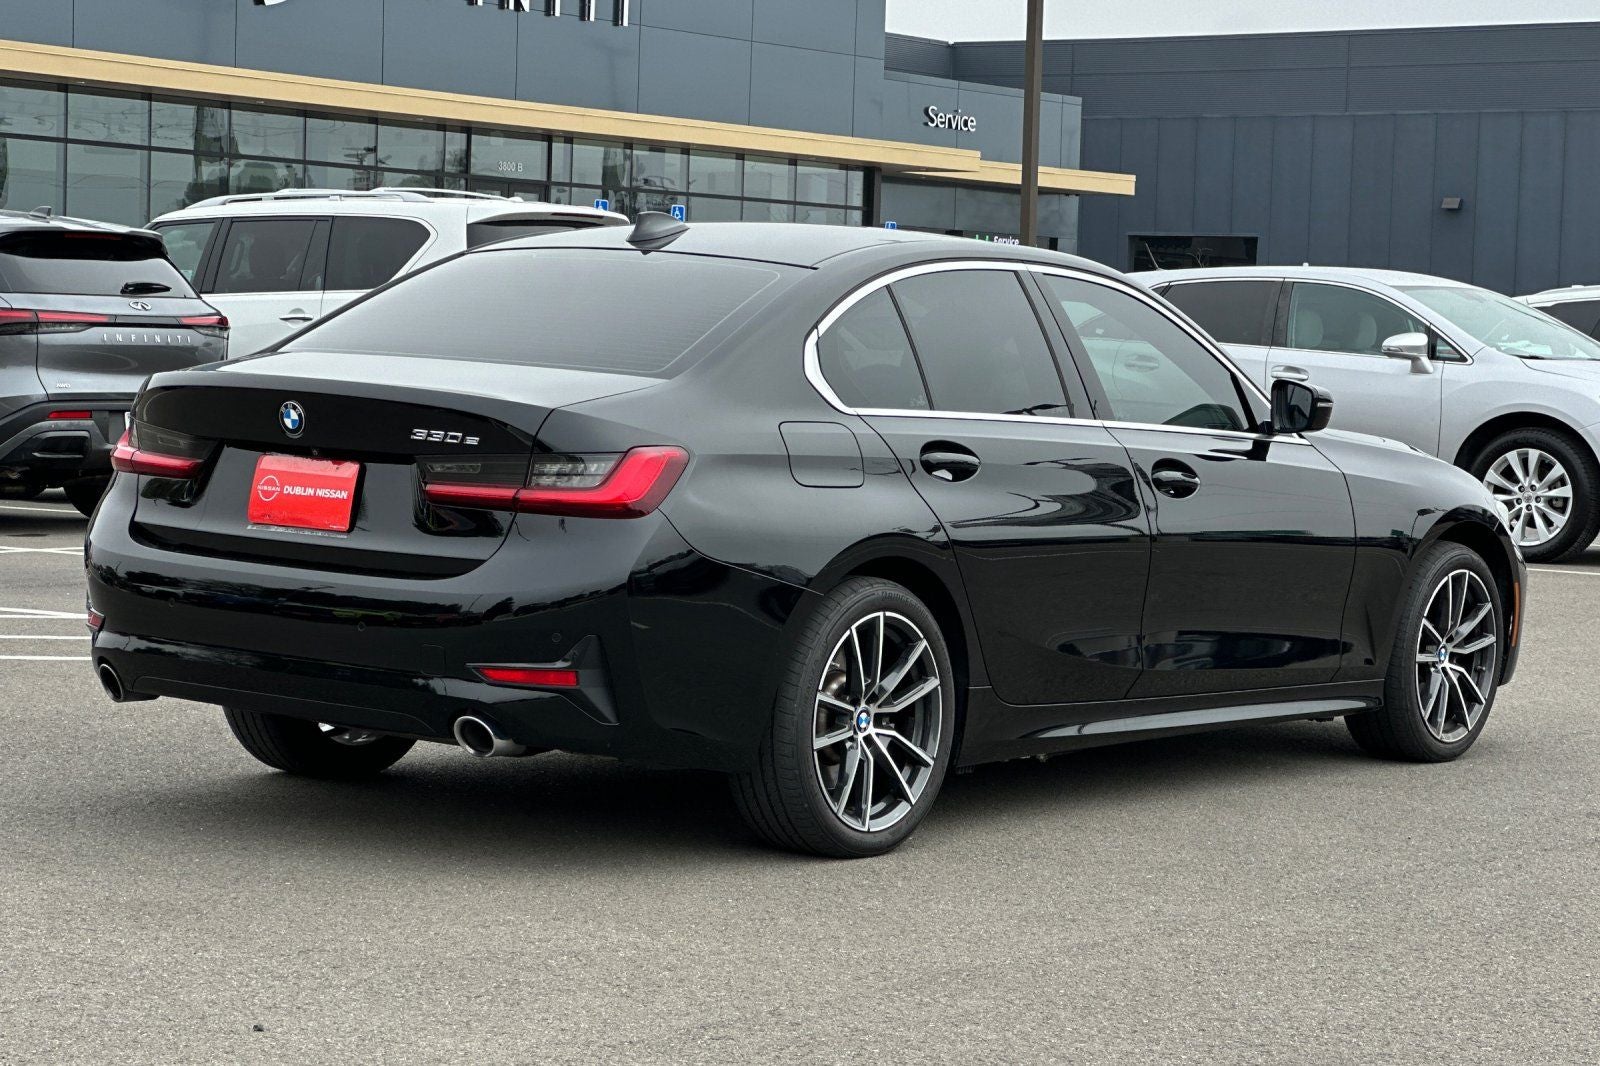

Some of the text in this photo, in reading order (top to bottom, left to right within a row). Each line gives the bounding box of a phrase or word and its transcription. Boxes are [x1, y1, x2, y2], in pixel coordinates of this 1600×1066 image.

[927, 105, 977, 132] Service
[498, 161, 523, 172] 3800 B
[103, 333, 192, 344] INFINITI
[257, 484, 281, 492] NISSAN
[283, 485, 348, 499] DUBLIN NISSAN
